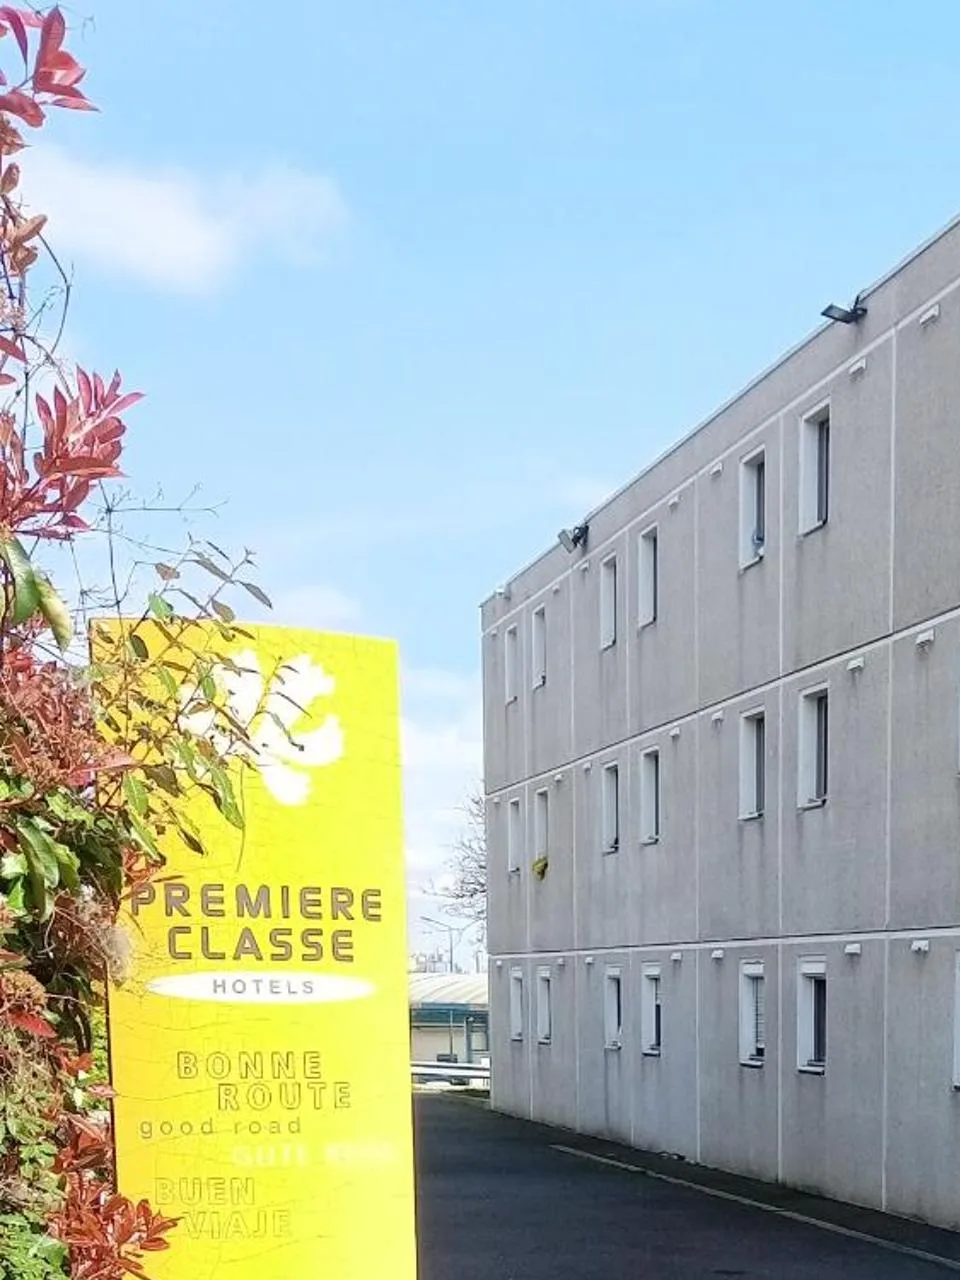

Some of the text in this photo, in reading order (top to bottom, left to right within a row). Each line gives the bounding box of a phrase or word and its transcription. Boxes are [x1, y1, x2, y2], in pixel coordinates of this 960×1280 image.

[130, 883, 382, 922] PREMIERE
[167, 926, 355, 962] CLASSE
[212, 979, 315, 995] HOTELS
[177, 1051, 323, 1080] BONNE
[217, 1082, 352, 1111] ROUTE
[140, 1117, 303, 1139] good road
[154, 1177, 256, 1206] BUEN
[182, 1208, 293, 1241] VIAJE
